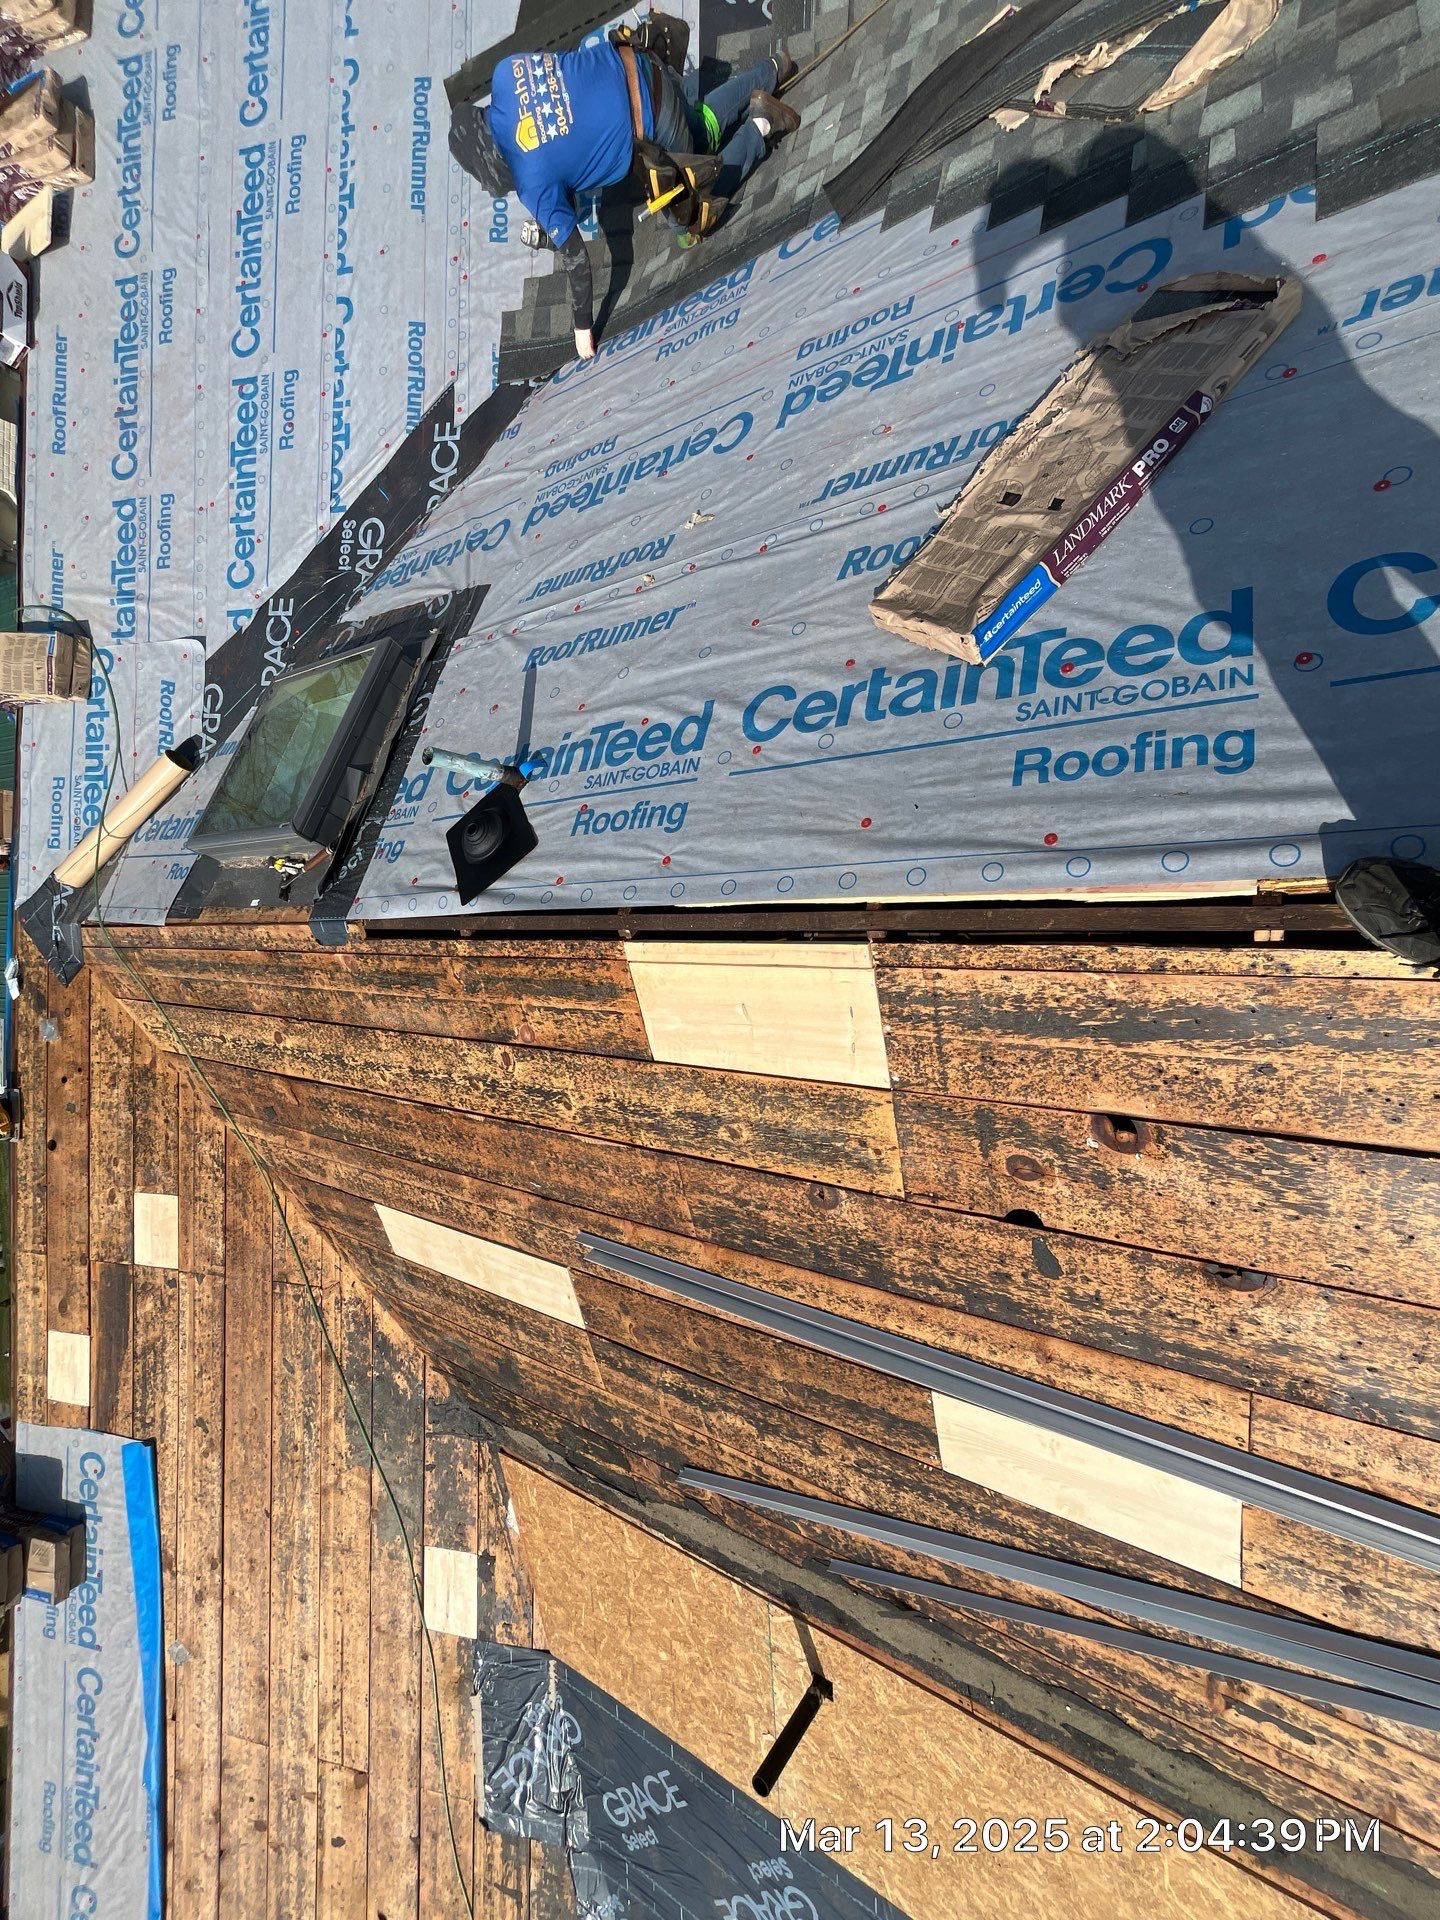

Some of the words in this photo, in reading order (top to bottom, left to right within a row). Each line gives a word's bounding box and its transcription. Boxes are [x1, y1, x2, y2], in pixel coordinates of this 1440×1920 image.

[161, 43, 181, 121] Roofing
[239, 0, 269, 127] Certain
[512, 59, 532, 118] Fahey
[114, 54, 143, 258] CertainTeed
[285, 134, 306, 214] Roofing
[231, 143, 265, 358] CertainTeed
[159, 267, 177, 345] Roofing
[655, 308, 741, 362] Roofing
[775, 237, 1173, 430] CertainTeed
[796, 295, 916, 361] Roofing
[111, 274, 139, 480] CertainTeed
[788, 329, 910, 389] SAINT-GOBAIN
[260, 374, 269, 454] SAINT-GOBAIN
[279, 369, 300, 450] Roofing
[227, 375, 258, 590] CertainTeed
[520, 411, 754, 537] CertainTeed
[534, 463, 610, 504] SAINT-GOBAIN
[544, 435, 620, 478] Roofing
[138, 497, 147, 573] SAINT-GOBAIN
[157, 493, 175, 569] Roofing
[1052, 473, 1132, 566] LANDMARK
[1132, 438, 1170, 478] PRO
[338, 519, 357, 571] Select
[991, 579, 1041, 635] certainteed
[742, 586, 1254, 742] CertainTeed
[1015, 664, 1254, 722] SAINT-GOBAIN
[82, 648, 114, 840] CertainTee
[584, 756, 701, 790] SAINT-GOBAIN
[1011, 728, 1255, 787] Roofing
[47, 776, 65, 849] Roofing
[570, 802, 689, 838] Roofing
[73, 1667, 103, 1867] CertainTeed
[602, 1769, 689, 1828] GRACE
[621, 1825, 660, 1851] Select
[747, 1856, 794, 1885] Select
